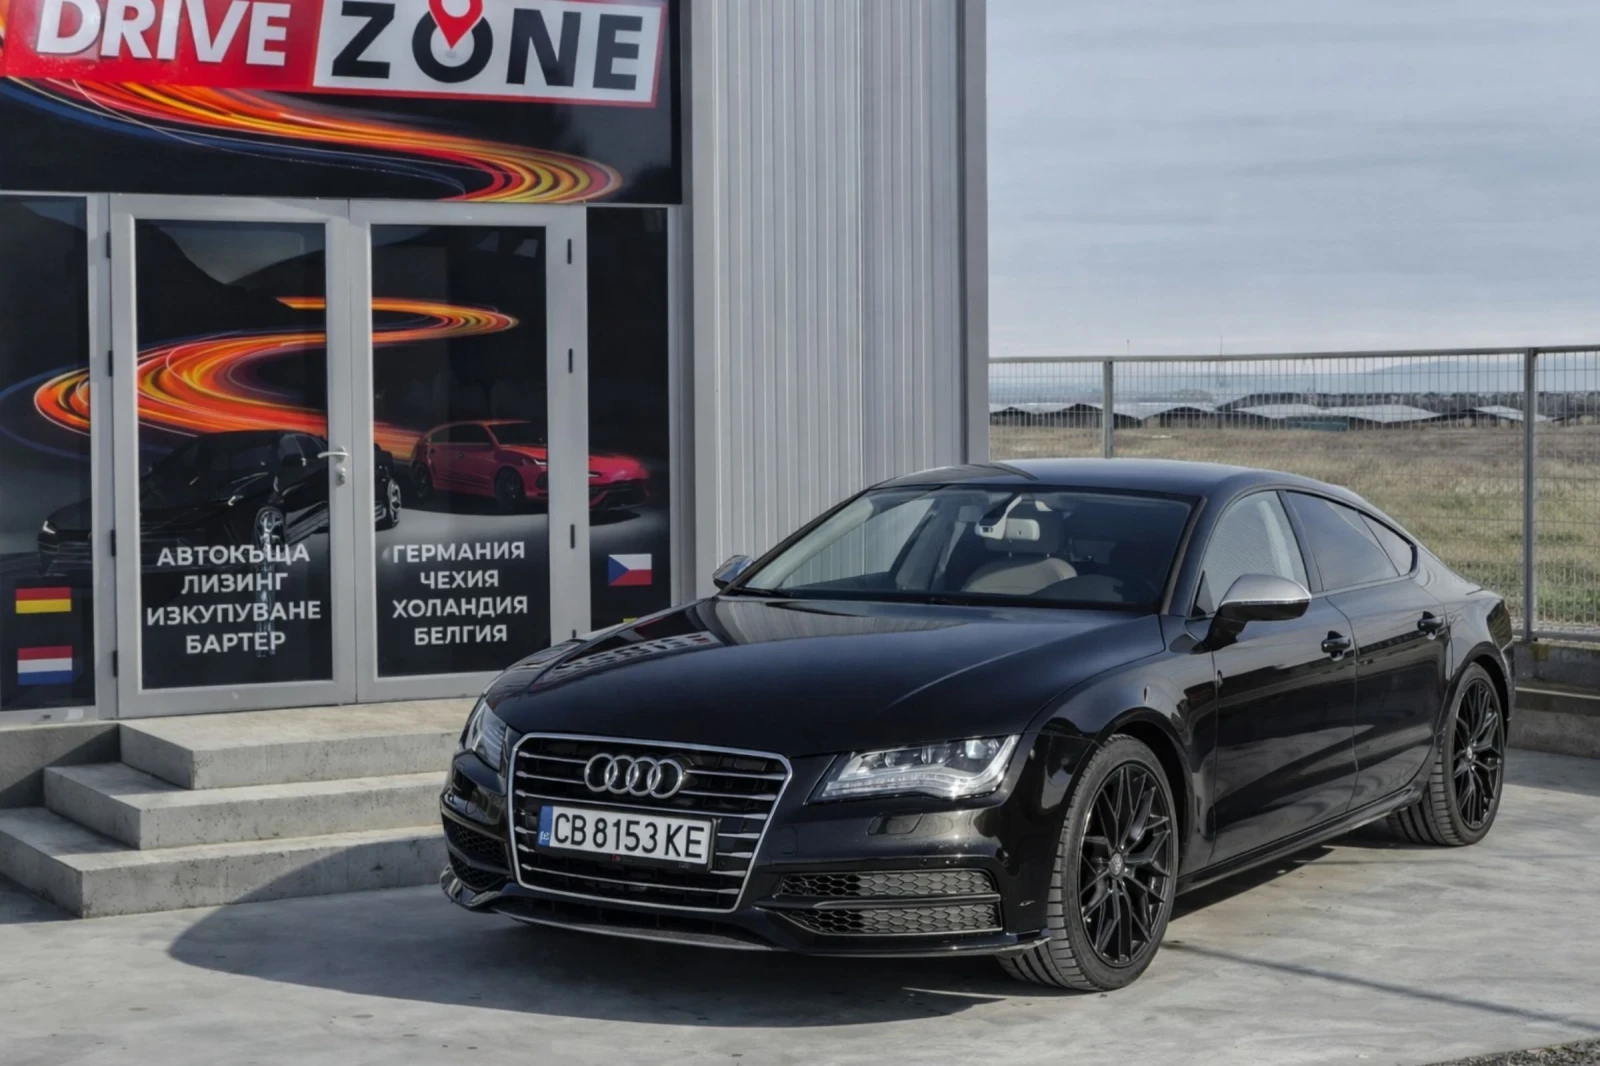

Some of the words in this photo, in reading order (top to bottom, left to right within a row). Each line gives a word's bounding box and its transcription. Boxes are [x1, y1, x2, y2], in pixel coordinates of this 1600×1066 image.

[36, 0, 291, 66] DRIVE
[331, 0, 643, 91] ZONE
[156, 543, 311, 567] АВТОКЪЩА
[393, 541, 525, 564] ГЕРМАНИЯ
[180, 572, 289, 595] ЛИЗИНГ
[420, 569, 499, 590] ЧЕХИЯ
[146, 600, 322, 626] ИЗКУПУВАНЕ
[392, 595, 529, 619] ХОЛАНДИЯ
[185, 630, 286, 655] БАРТЕР
[414, 624, 508, 646] БЕЛГИЯ
[592, 817, 659, 854] 8153
